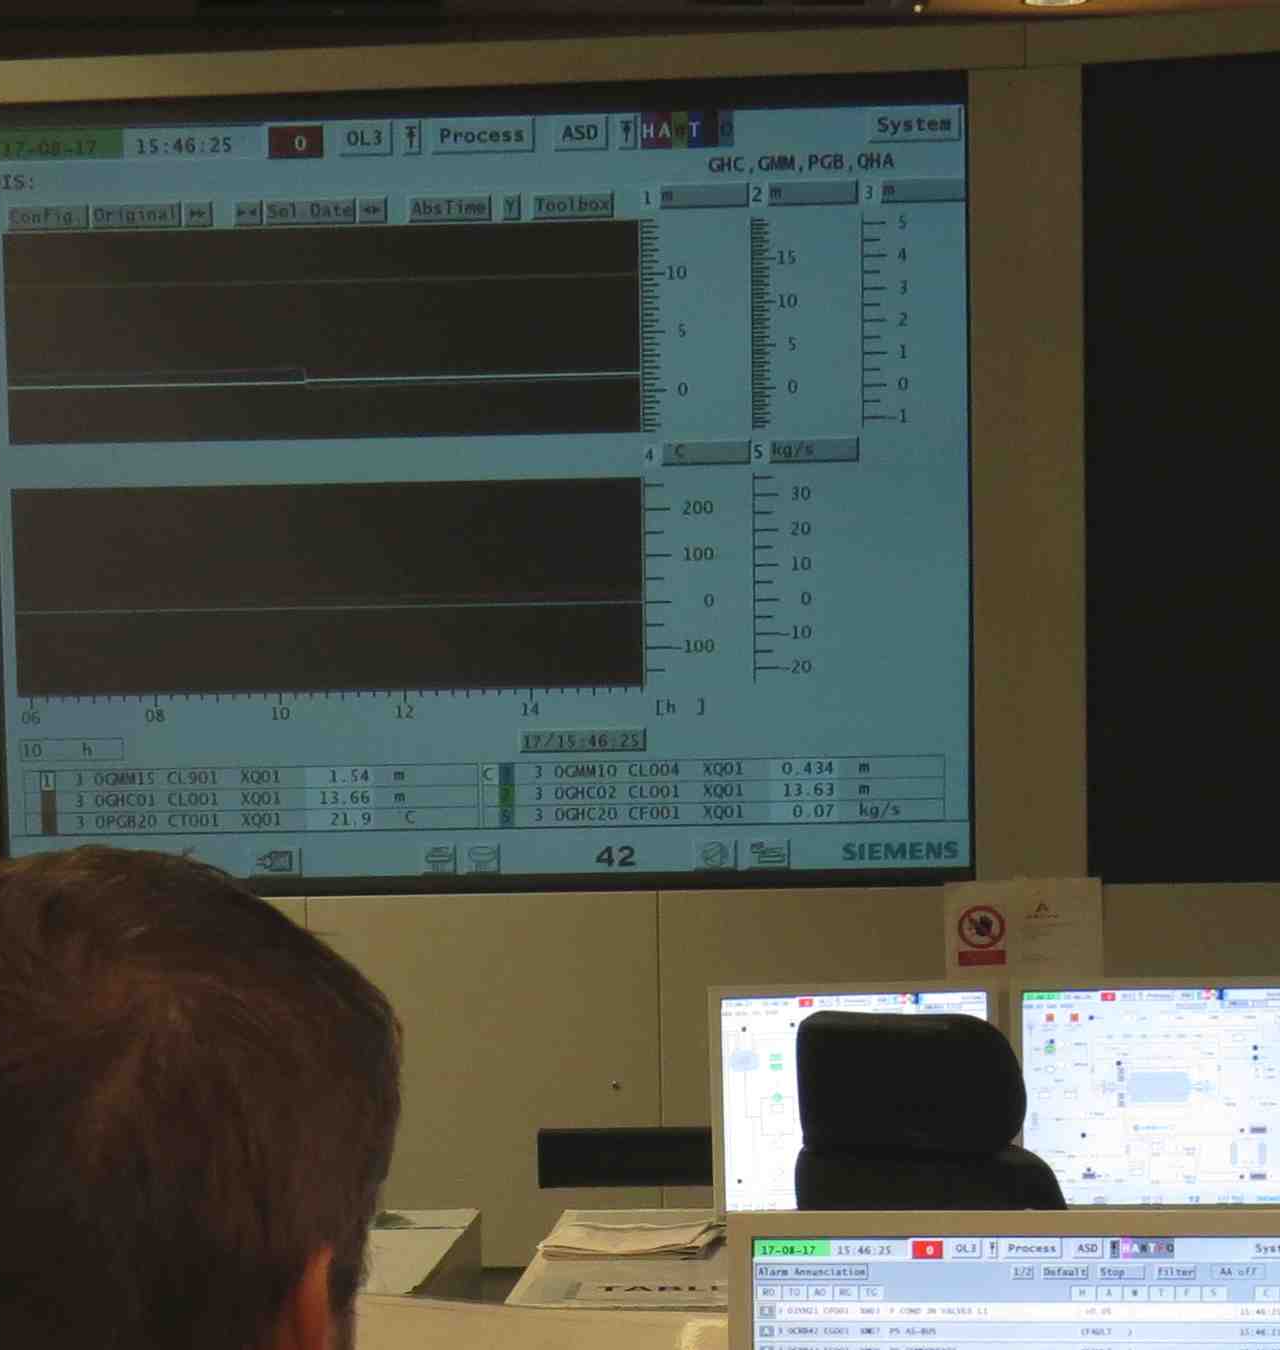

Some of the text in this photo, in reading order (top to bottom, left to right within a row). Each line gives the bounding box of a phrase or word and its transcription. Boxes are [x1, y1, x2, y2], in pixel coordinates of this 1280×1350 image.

[136, 136, 232, 155] 15:46:25
[347, 130, 383, 147] OL3
[439, 127, 525, 145] Process
[562, 124, 598, 141] ASD
[877, 115, 952, 134] System
[411, 198, 487, 217] AbsTime
[536, 197, 609, 214] Toolbox
[777, 250, 797, 267] 15
[667, 265, 687, 281] 10
[777, 294, 798, 310] 10
[771, 442, 814, 462] kg/s
[791, 486, 811, 502] 30
[682, 500, 714, 516] 200
[790, 521, 811, 537] 20
[683, 546, 715, 562] 100
[792, 556, 812, 572] 10
[145, 708, 166, 724] 08
[271, 706, 290, 721] 10
[395, 704, 415, 720] 12
[520, 702, 540, 717] 14
[329, 768, 369, 784] 1.54
[629, 762, 680, 779] CL004
[703, 761, 744, 778] XQ01
[782, 761, 834, 778] 0.434
[320, 790, 370, 806] 13.66
[629, 783, 680, 800] CL001
[703, 782, 744, 799] XQ01
[783, 782, 835, 798] 13.63
[629, 804, 681, 821] CF001
[703, 803, 744, 820] XQ01
[793, 803, 834, 820] 0.07
[858, 801, 901, 820] kg/s
[168, 812, 219, 829] CT001
[330, 811, 372, 827] 21.9
[596, 841, 959, 867] 42 SIEMENS
[1008, 1243, 1056, 1254] Process
[758, 1267, 789, 1277] Alarm
